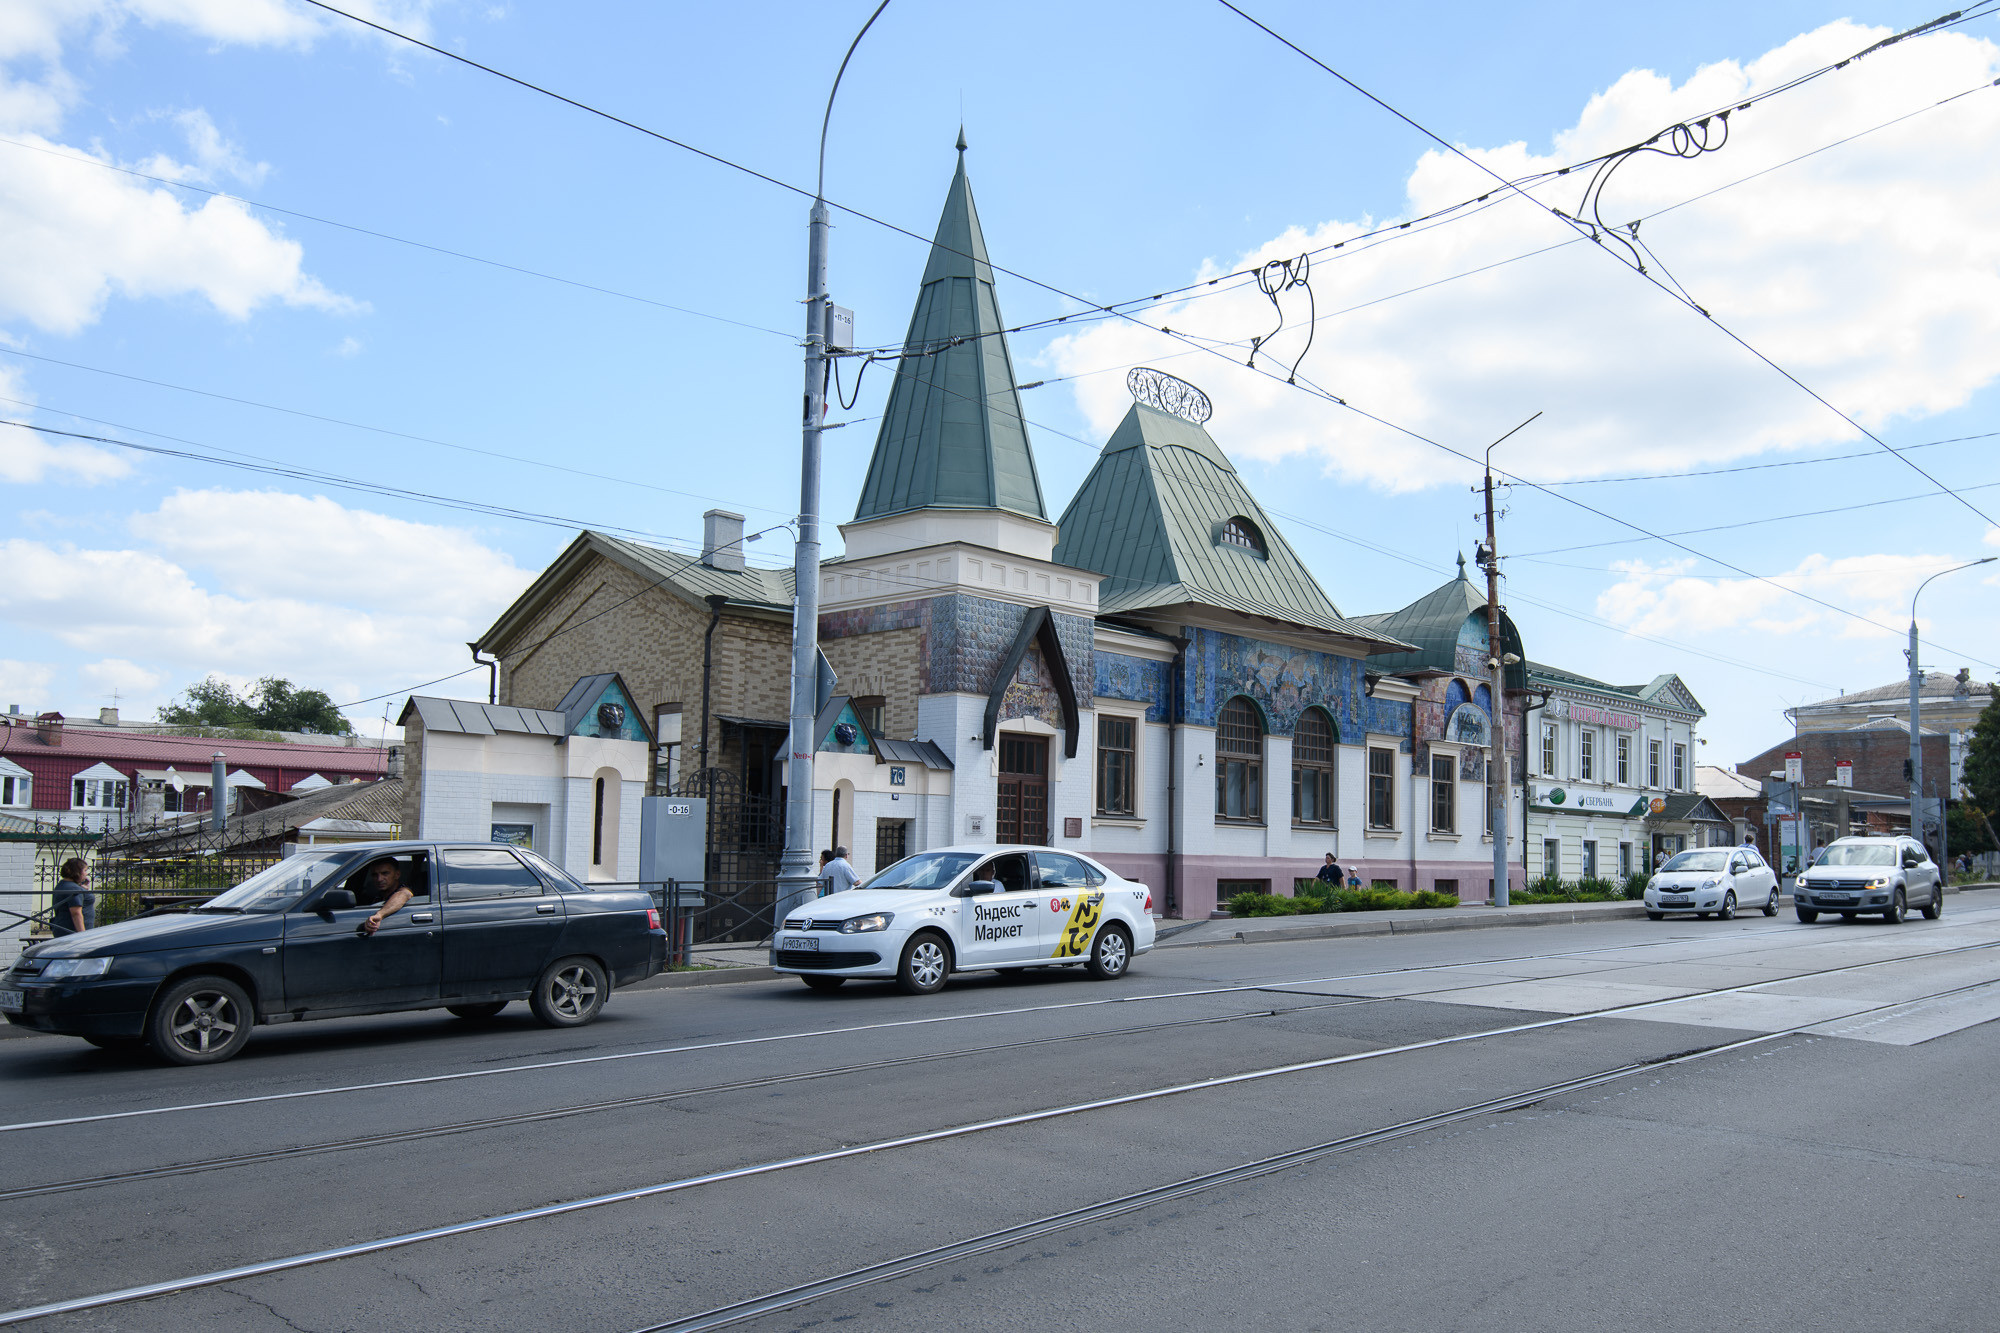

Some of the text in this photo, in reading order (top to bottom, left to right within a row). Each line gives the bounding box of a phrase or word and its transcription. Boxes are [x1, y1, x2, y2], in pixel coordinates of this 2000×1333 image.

[892, 768, 904, 784] 70
[1585, 796, 1614, 807] СБЕРБАНК
[974, 904, 1021, 922] Яндекс
[974, 924, 1023, 942] Маркет
